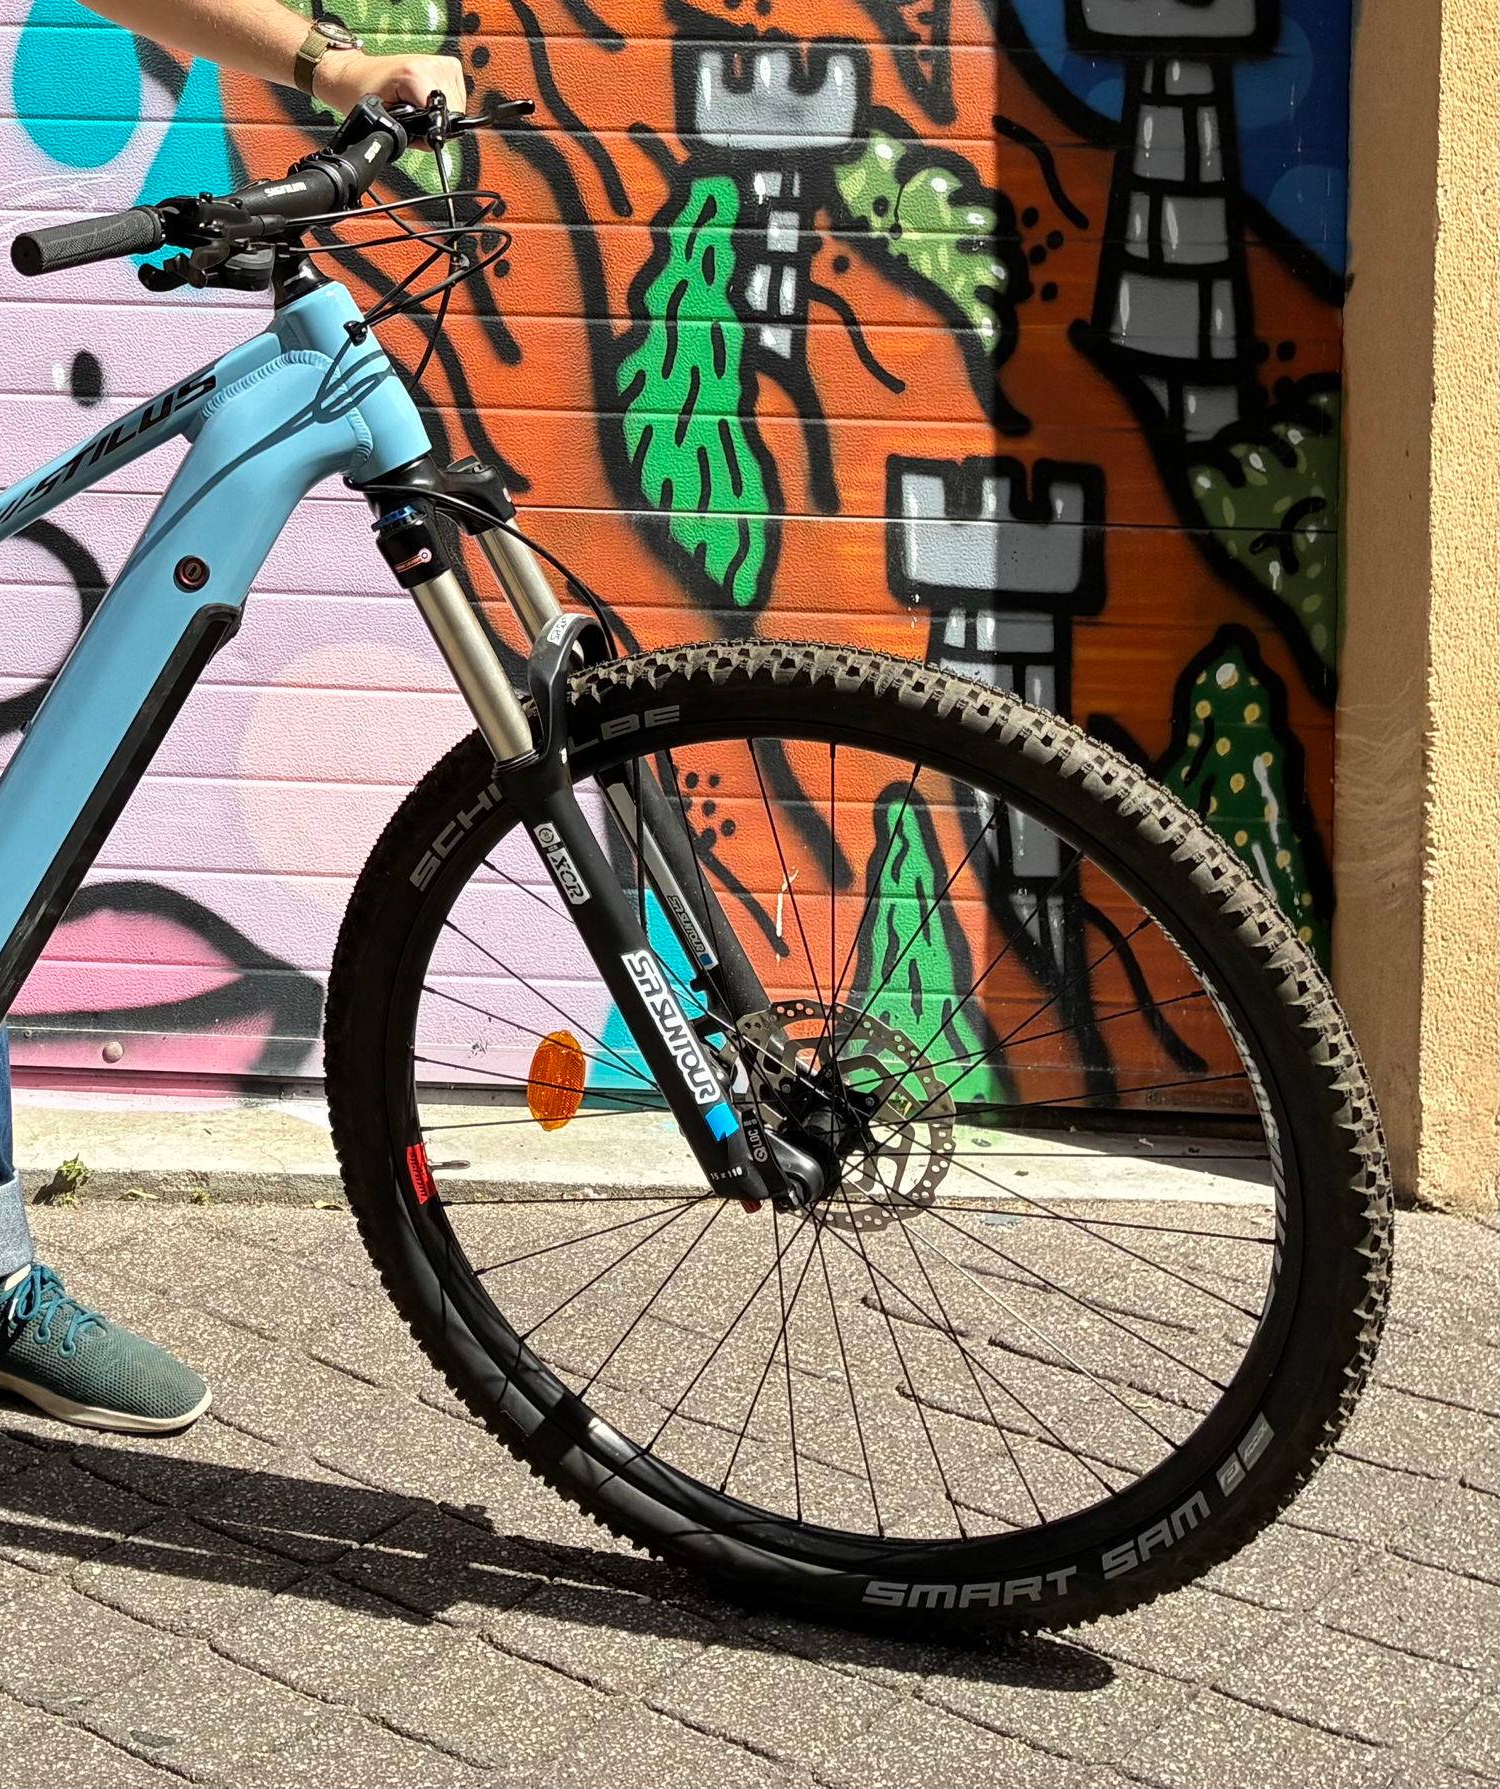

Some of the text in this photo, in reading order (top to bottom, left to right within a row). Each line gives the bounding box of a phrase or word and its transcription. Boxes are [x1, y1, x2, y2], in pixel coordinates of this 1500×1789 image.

[17, 374, 217, 513] STILUS
[550, 856, 584, 898] XCR
[624, 951, 719, 1102] SR SUNTOUR
[862, 1490, 1212, 1609] SMART SAM
